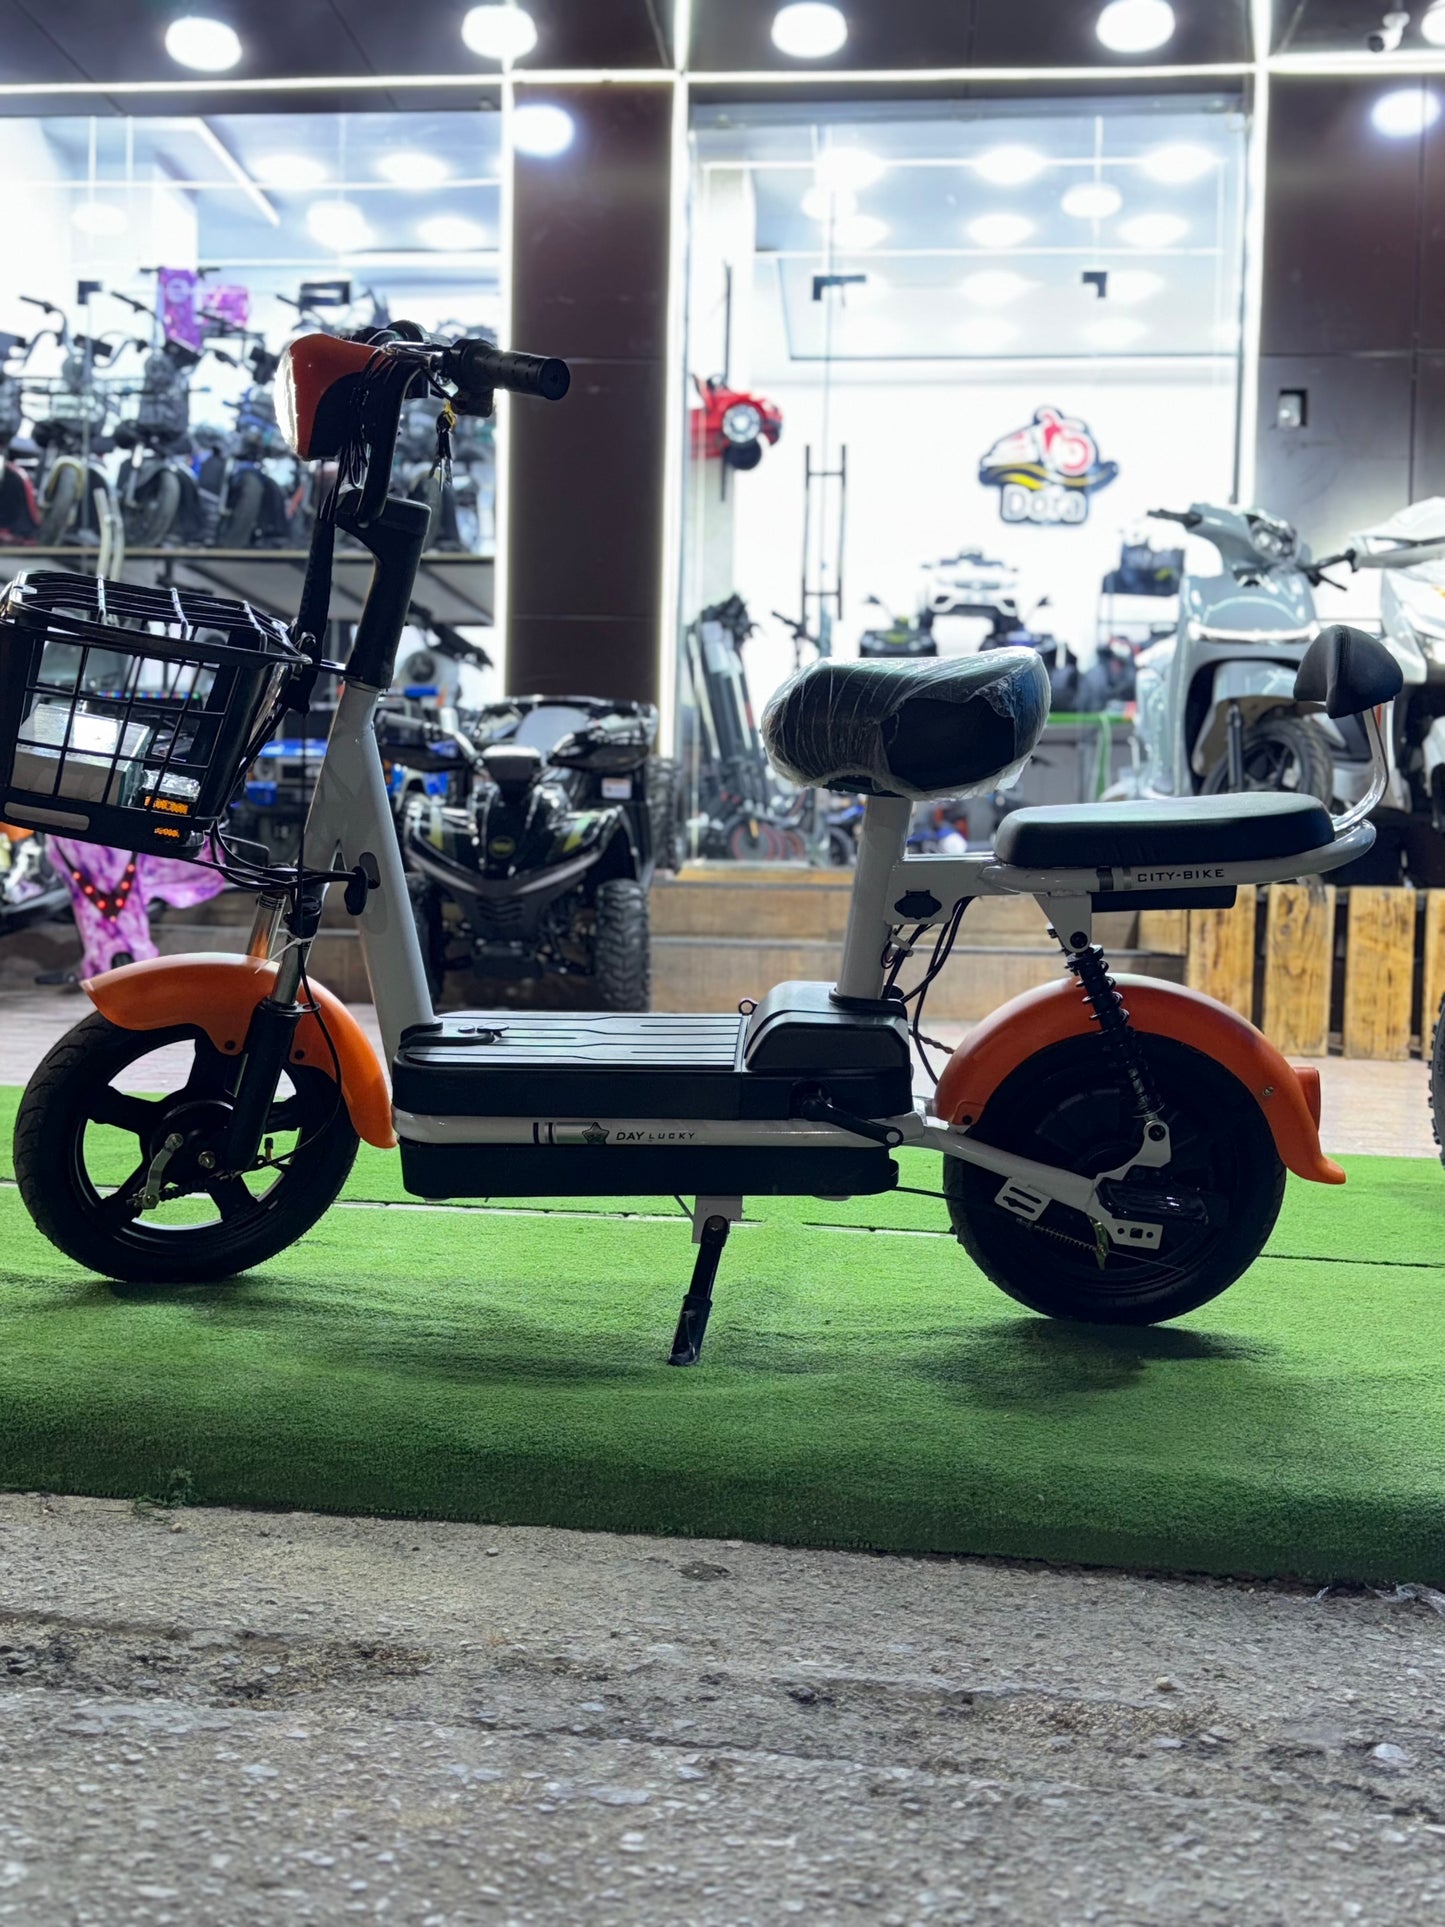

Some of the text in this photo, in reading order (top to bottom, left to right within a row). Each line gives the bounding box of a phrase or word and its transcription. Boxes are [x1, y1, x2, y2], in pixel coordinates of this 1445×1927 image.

[1137, 868, 1225, 882] CITY-BIKE
[615, 1131, 695, 1141] DAY LUCKY
